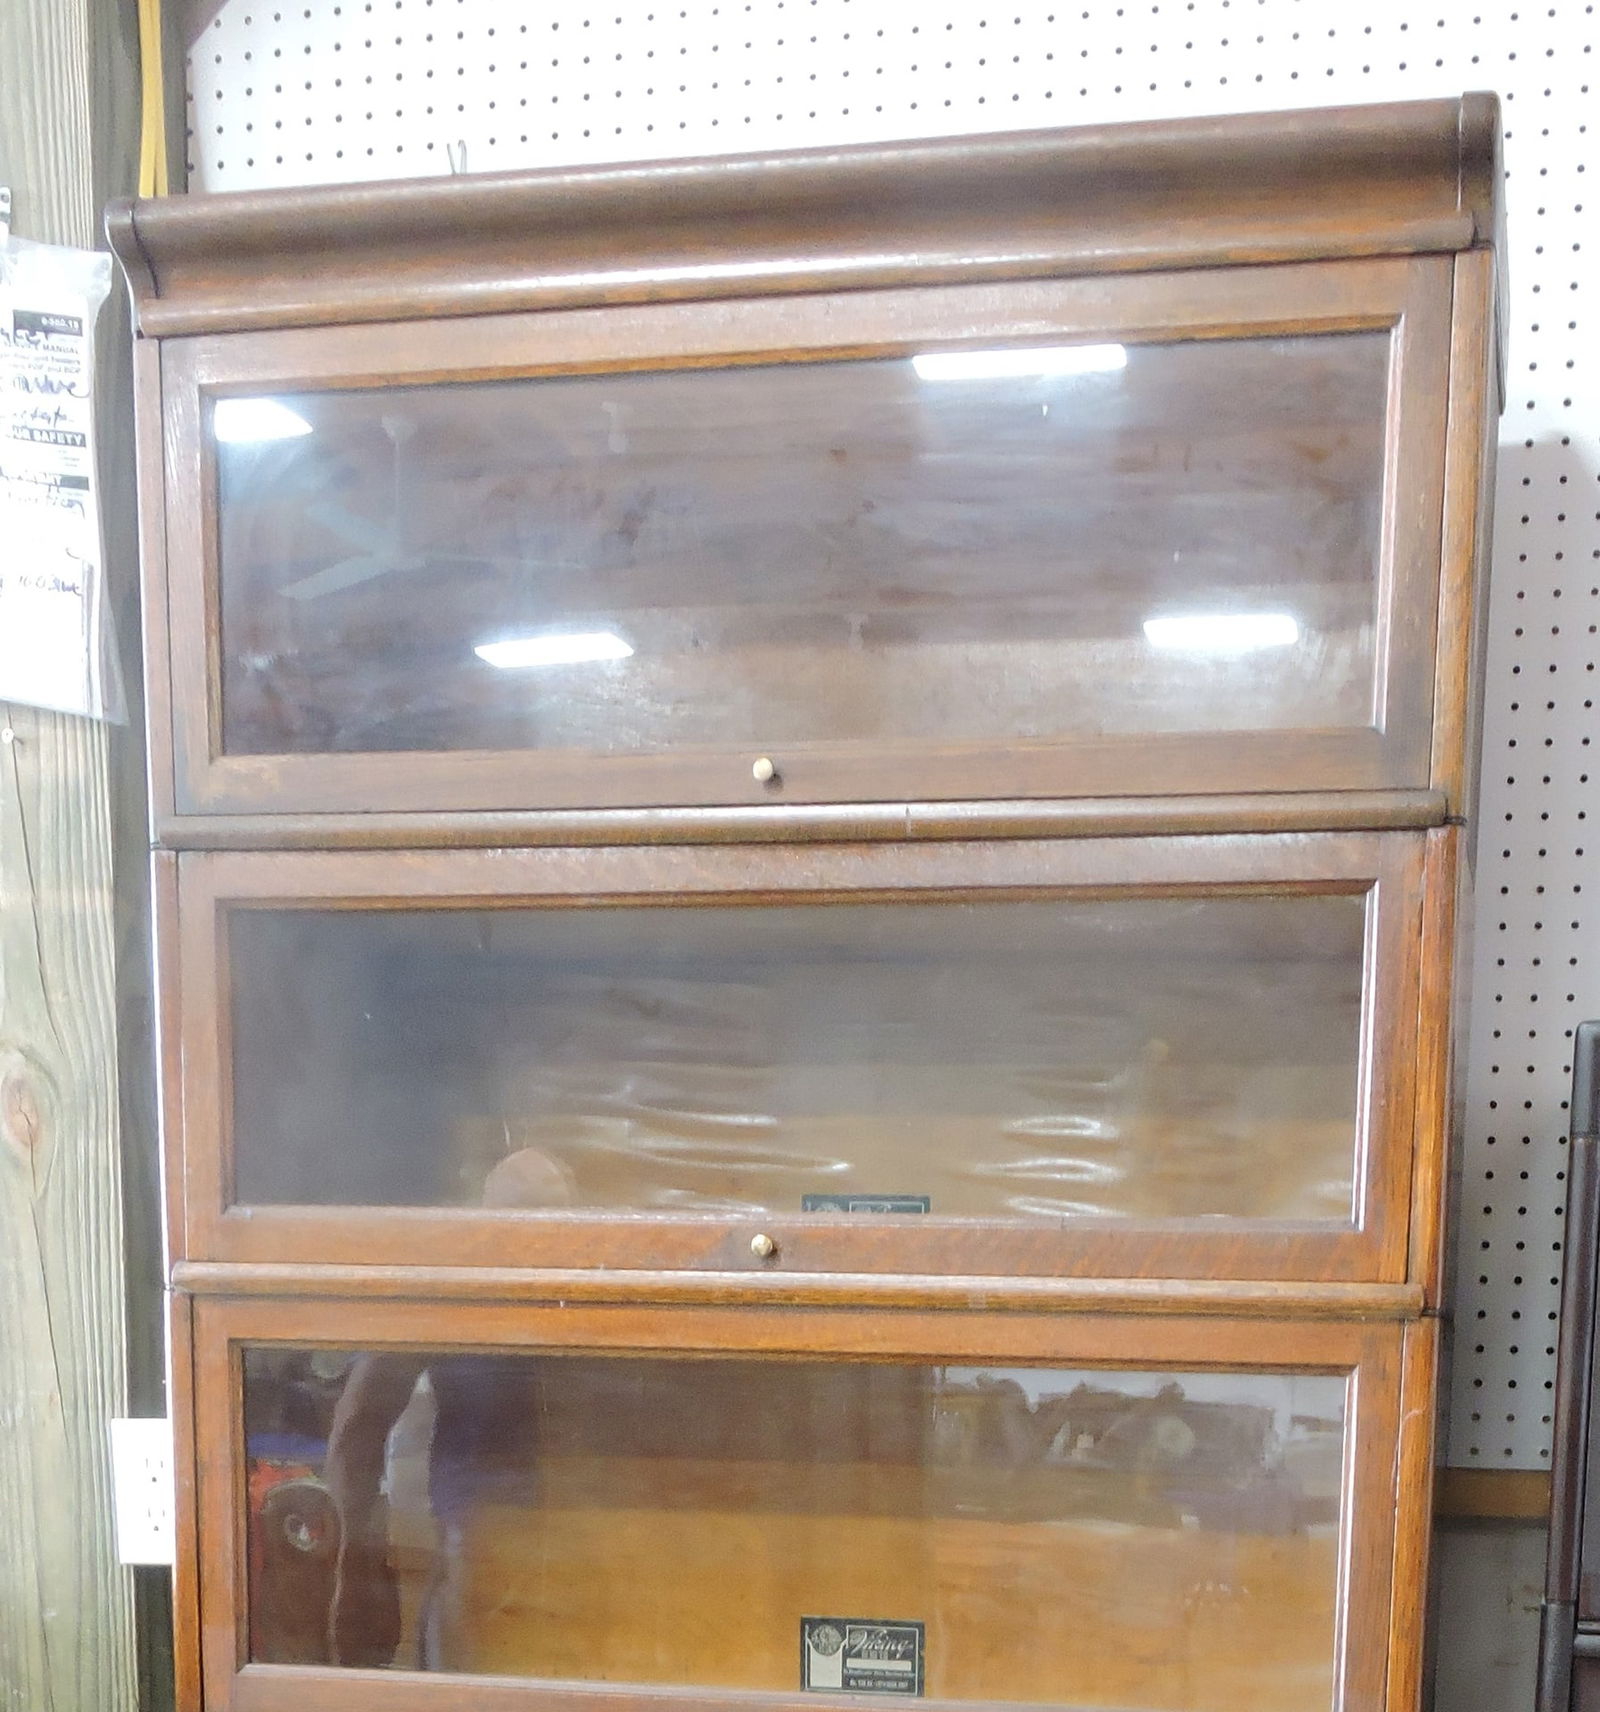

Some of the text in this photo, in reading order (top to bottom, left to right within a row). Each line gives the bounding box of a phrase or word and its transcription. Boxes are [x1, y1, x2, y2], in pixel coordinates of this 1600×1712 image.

[43, 344, 79, 355] MANUAL
[33, 429, 82, 446] SAFETY
[850, 1629, 914, 1660] Viking
